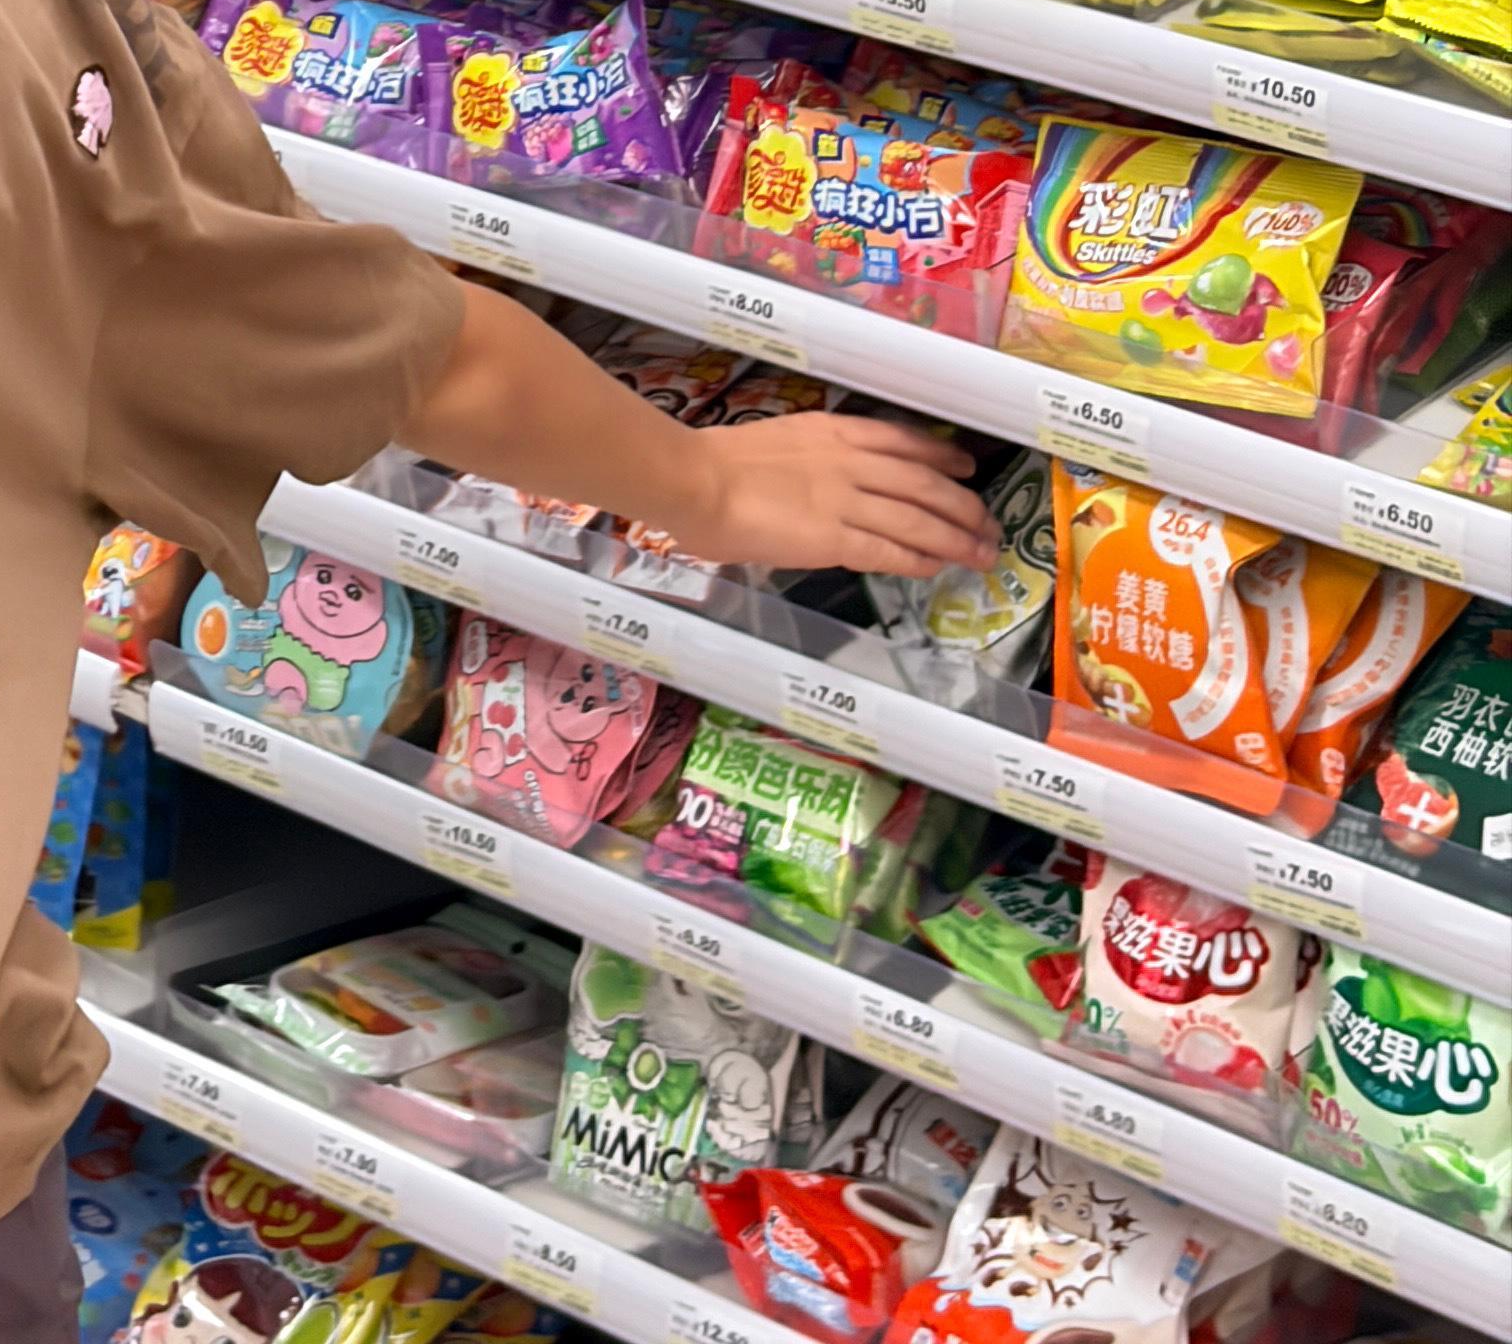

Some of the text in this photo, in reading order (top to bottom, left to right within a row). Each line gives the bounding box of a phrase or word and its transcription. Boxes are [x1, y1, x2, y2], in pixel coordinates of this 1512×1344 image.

[1069, 181, 1194, 240] 彩虹
[1076, 242, 1159, 266] Skittles
[1158, 509, 1212, 542] 26.4
[1440, 683, 1512, 737] 羽衣
